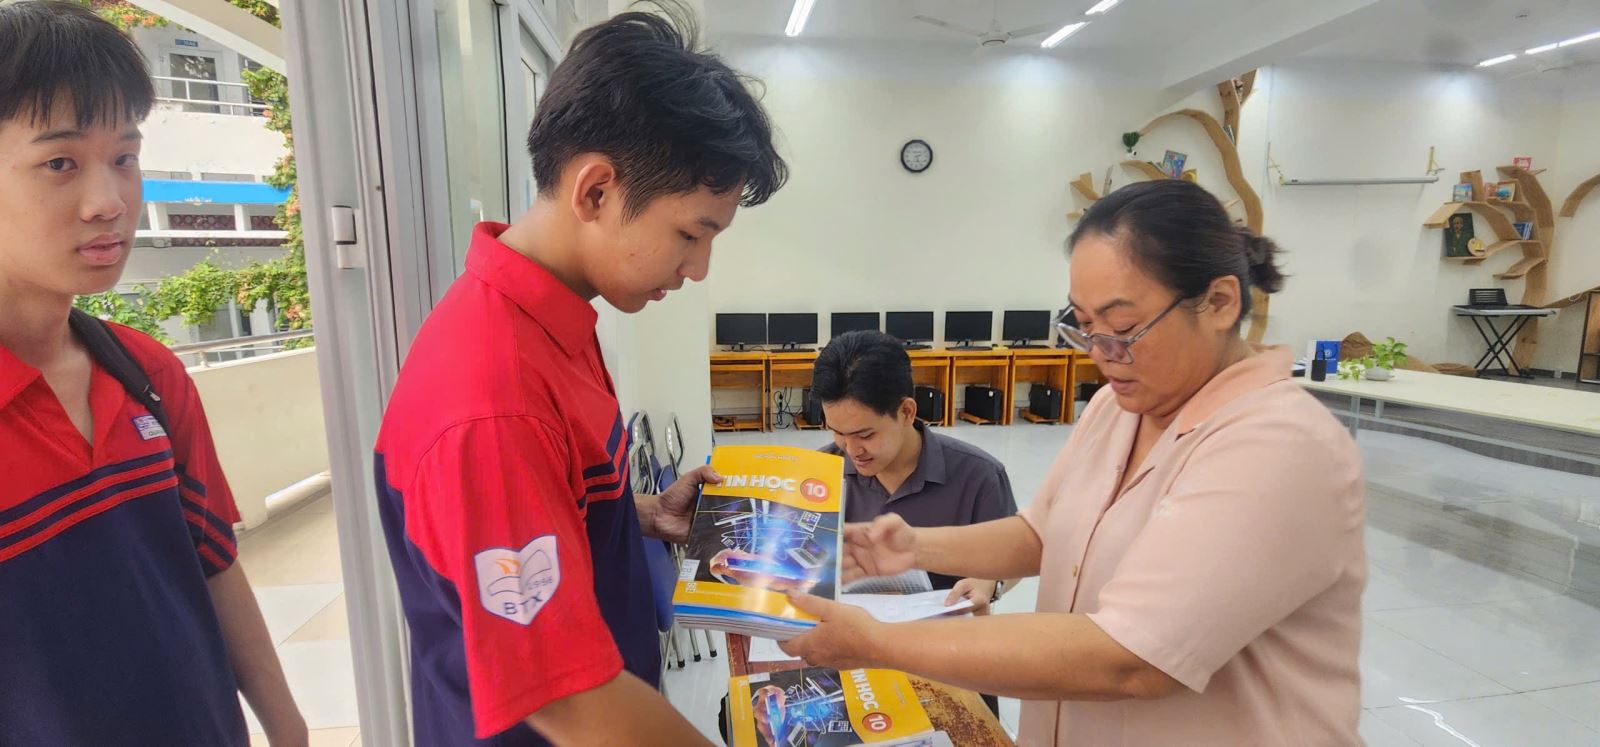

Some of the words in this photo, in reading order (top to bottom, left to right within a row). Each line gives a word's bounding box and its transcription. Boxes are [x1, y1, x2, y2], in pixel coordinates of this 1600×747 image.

[749, 474, 797, 492] HỌC
[805, 482, 826, 498] 10
[503, 591, 543, 615] BTX
[849, 667, 869, 684] IN
[855, 682, 879, 711] HỌC
[868, 715, 887, 731] 10
